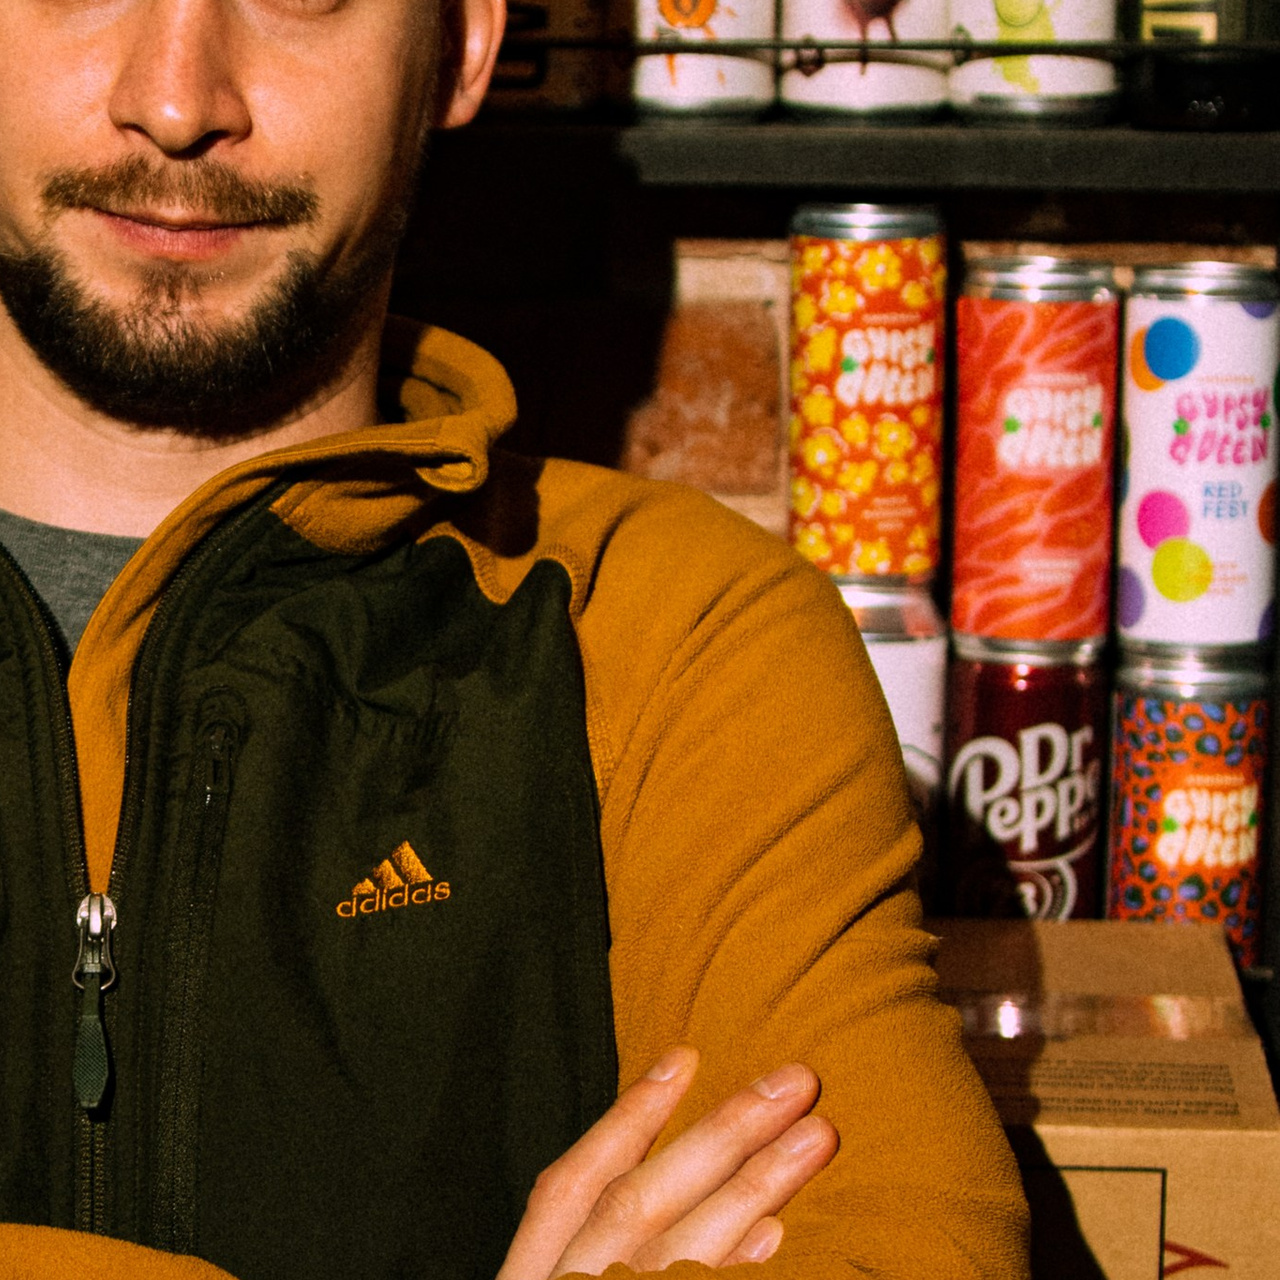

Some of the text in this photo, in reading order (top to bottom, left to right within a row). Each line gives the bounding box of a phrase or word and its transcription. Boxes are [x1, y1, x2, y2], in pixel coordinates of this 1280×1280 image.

[1175, 388, 1270, 431] GYPSY
[1170, 428, 1269, 466] QUEEN
[1016, 721, 1094, 791] Dr
[949, 735, 1100, 854] Pepp
[335, 880, 452, 918] adidas
